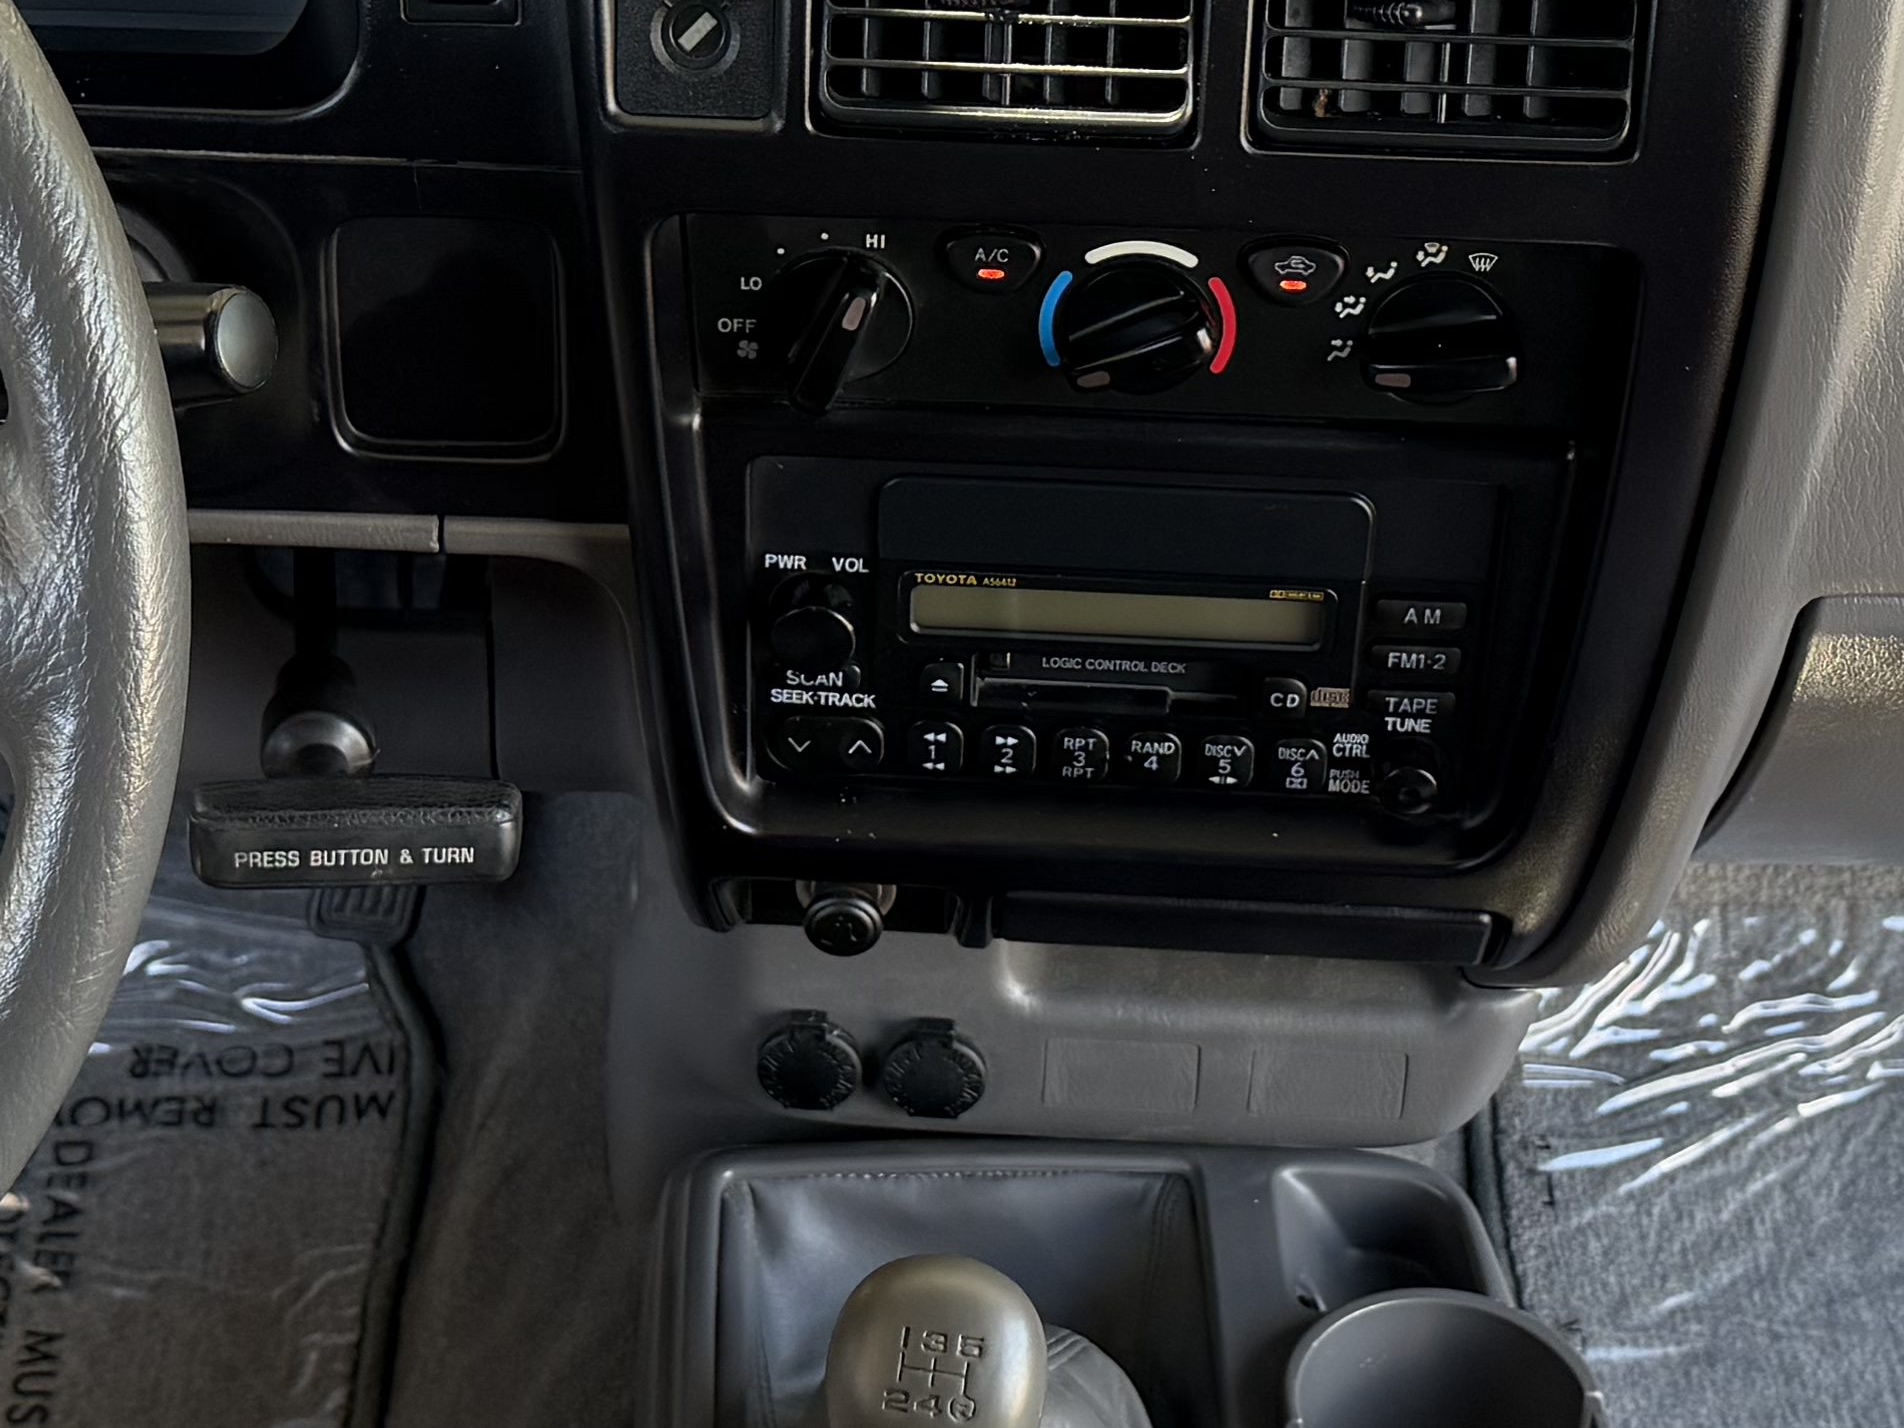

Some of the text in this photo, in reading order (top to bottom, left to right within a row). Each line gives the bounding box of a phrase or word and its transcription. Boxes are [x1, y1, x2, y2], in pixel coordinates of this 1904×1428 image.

[865, 232, 887, 251] HI
[974, 246, 1010, 264] A/C
[739, 275, 763, 292] LO
[716, 316, 758, 335] OFF
[764, 553, 870, 573] PWR VOL
[914, 573, 978, 586] TOYOTA
[1041, 657, 1187, 674] LOGIC CONTROL DECK
[785, 670, 844, 688] SCAN
[1384, 696, 1438, 715] TAPE
[1384, 716, 1433, 734] TUNE
[1063, 736, 1097, 751] RPT
[1333, 732, 1370, 744] AUDIO
[928, 744, 938, 760] 1
[1131, 739, 1176, 755] RAND
[1332, 743, 1371, 759] CTRL
[1000, 748, 1014, 764] 2
[1073, 751, 1086, 767] 3
[1143, 755, 1159, 771] 4
[1217, 758, 1232, 774] 5
[1290, 761, 1305, 778] 6
[1328, 768, 1361, 780] PUSH
[1327, 778, 1371, 794] MODE
[234, 846, 476, 869] PRESS BUTTON & TURN
[129, 1040, 293, 1079] COVER
[53, 1088, 395, 1131] MUST REMO
